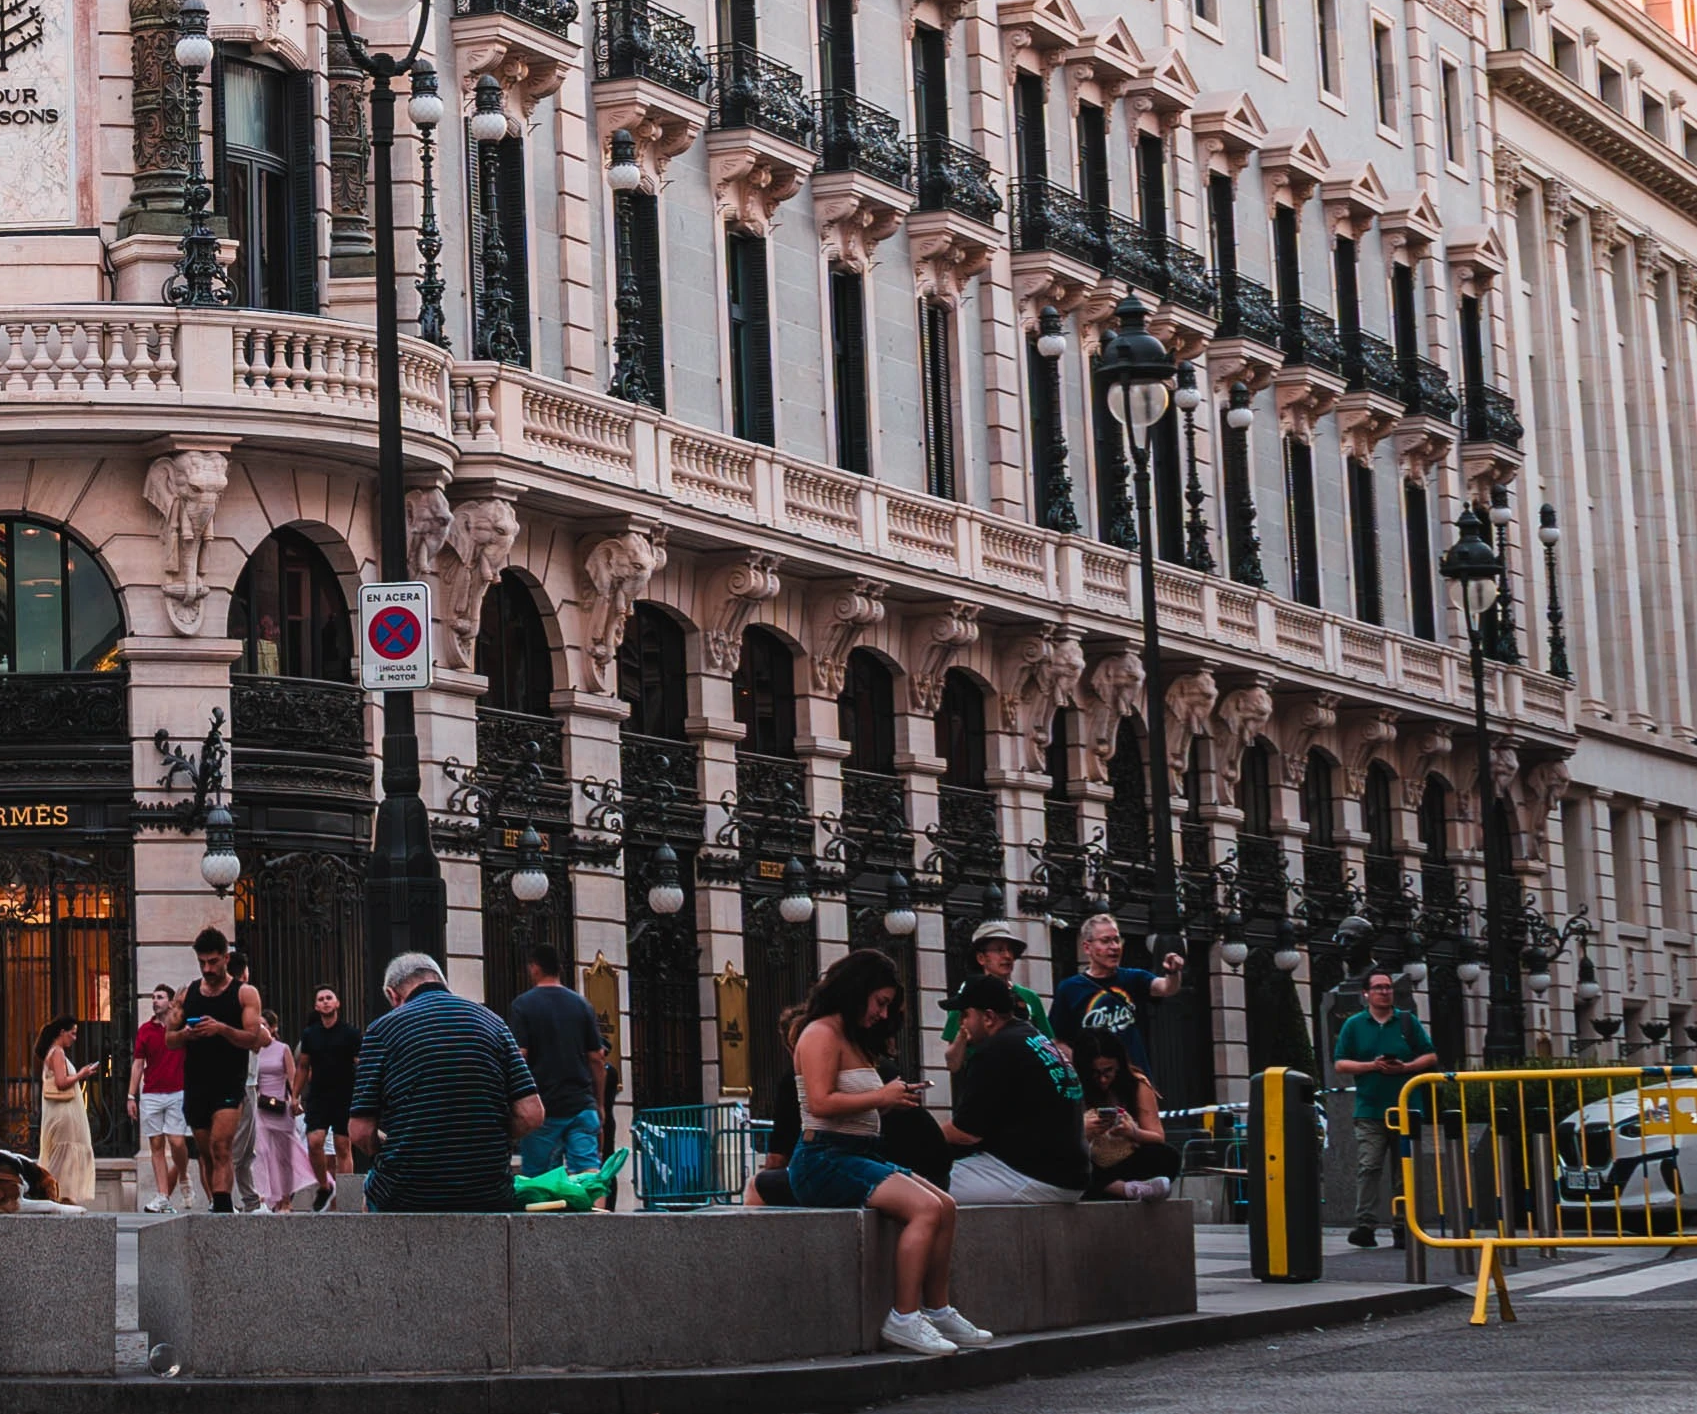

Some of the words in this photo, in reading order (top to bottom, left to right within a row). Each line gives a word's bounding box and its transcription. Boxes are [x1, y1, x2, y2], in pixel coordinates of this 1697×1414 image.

[366, 593, 381, 602] EN
[385, 592, 420, 602] ACERA
[388, 673, 416, 681] MOTOR
